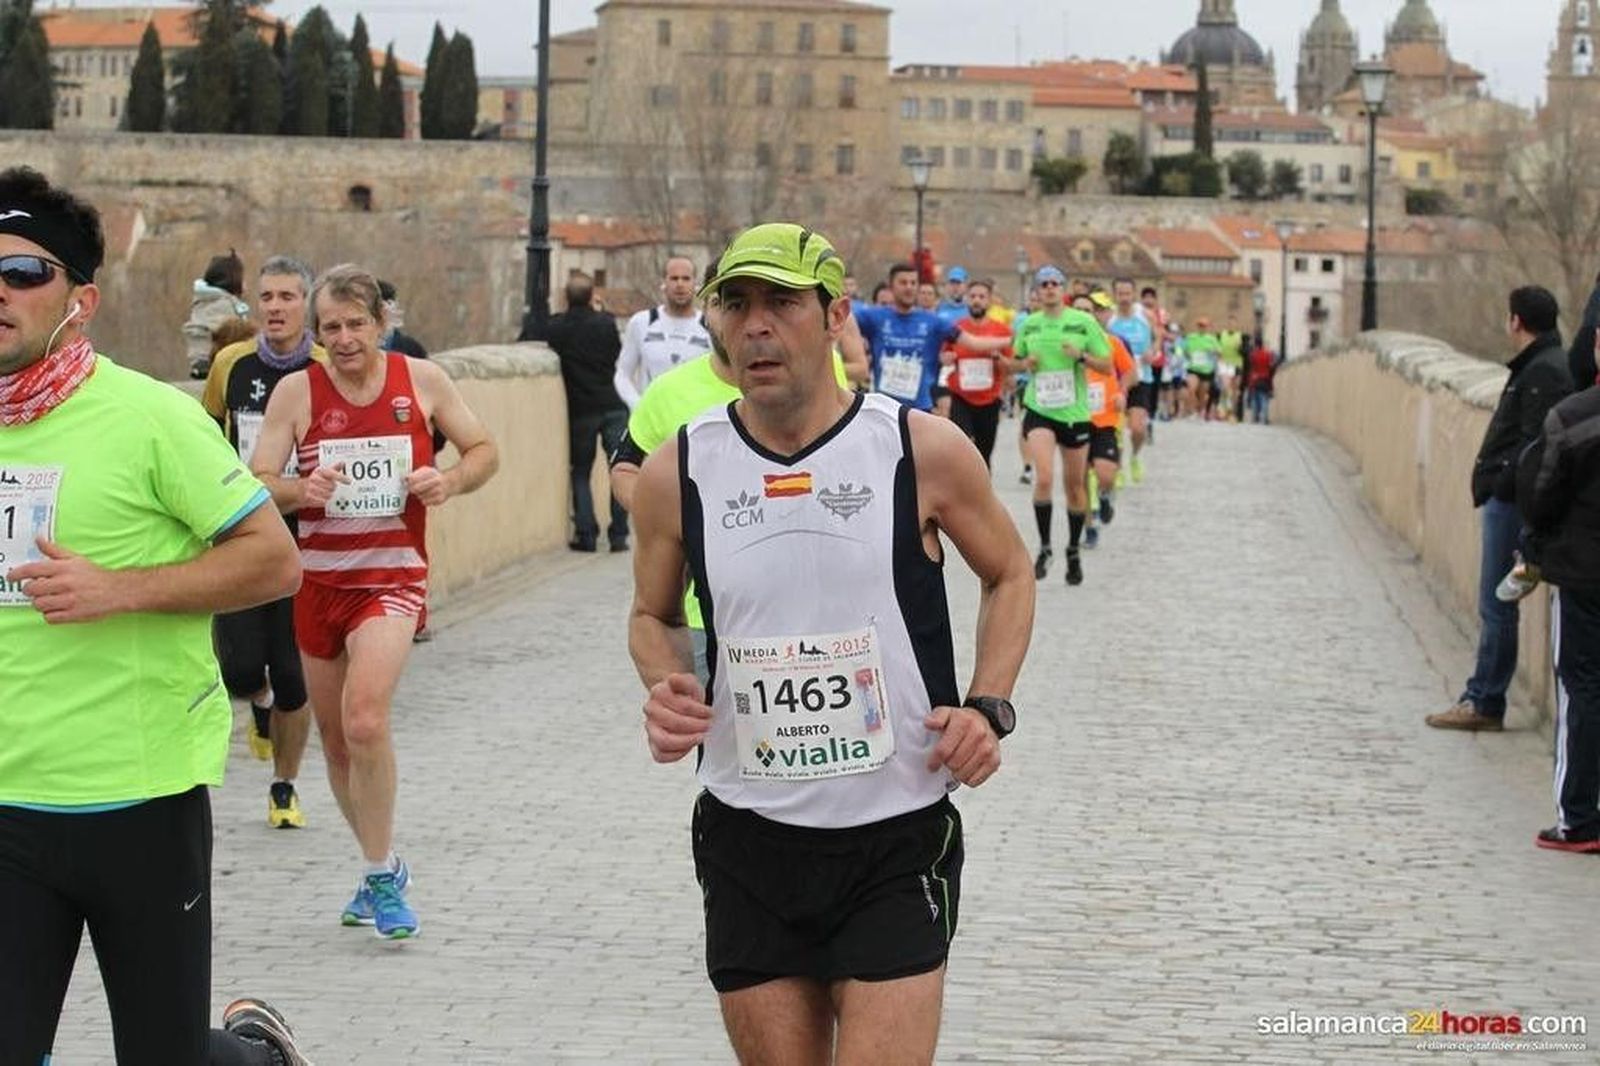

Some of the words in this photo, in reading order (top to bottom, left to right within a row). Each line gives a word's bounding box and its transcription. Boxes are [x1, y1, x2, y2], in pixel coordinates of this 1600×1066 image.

[352, 494, 401, 510] vialia
[722, 508, 764, 529] CCM
[727, 643, 742, 664] IV
[743, 647, 778, 658] MEDIA
[832, 637, 870, 655] 2015
[753, 675, 853, 714] 1463
[776, 723, 830, 737] ALBERTO
[779, 738, 871, 767] vialia
